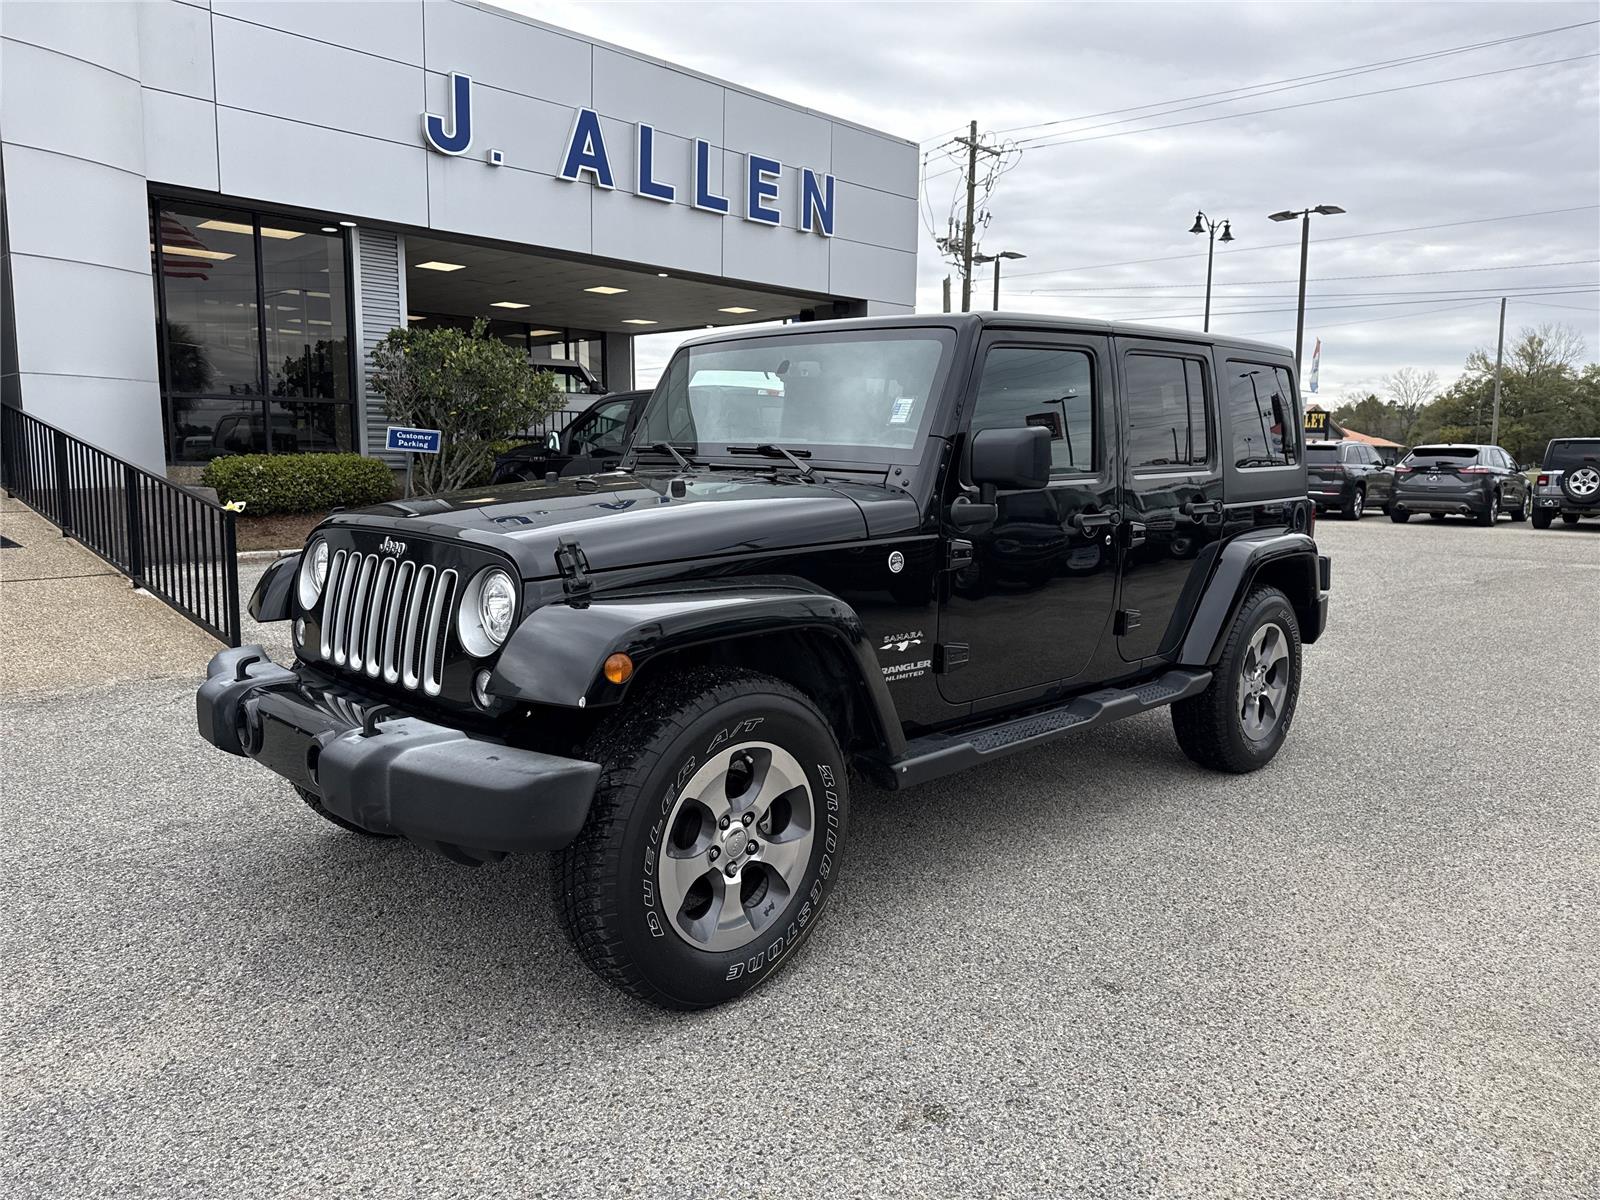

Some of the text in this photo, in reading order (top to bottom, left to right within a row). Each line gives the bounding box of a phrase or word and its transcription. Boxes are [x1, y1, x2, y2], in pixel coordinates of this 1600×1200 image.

[421, 71, 836, 237] J. ALLEN
[396, 431, 432, 441] Customer
[398, 439, 429, 449] Parking
[379, 536, 407, 558] Jeep
[883, 630, 924, 643] SAHARA
[881, 659, 932, 675] RANGLER
[885, 670, 925, 682] NLIMITED
[643, 717, 764, 938] DUELER A/T
[726, 763, 839, 981] BRIDGESTONE
